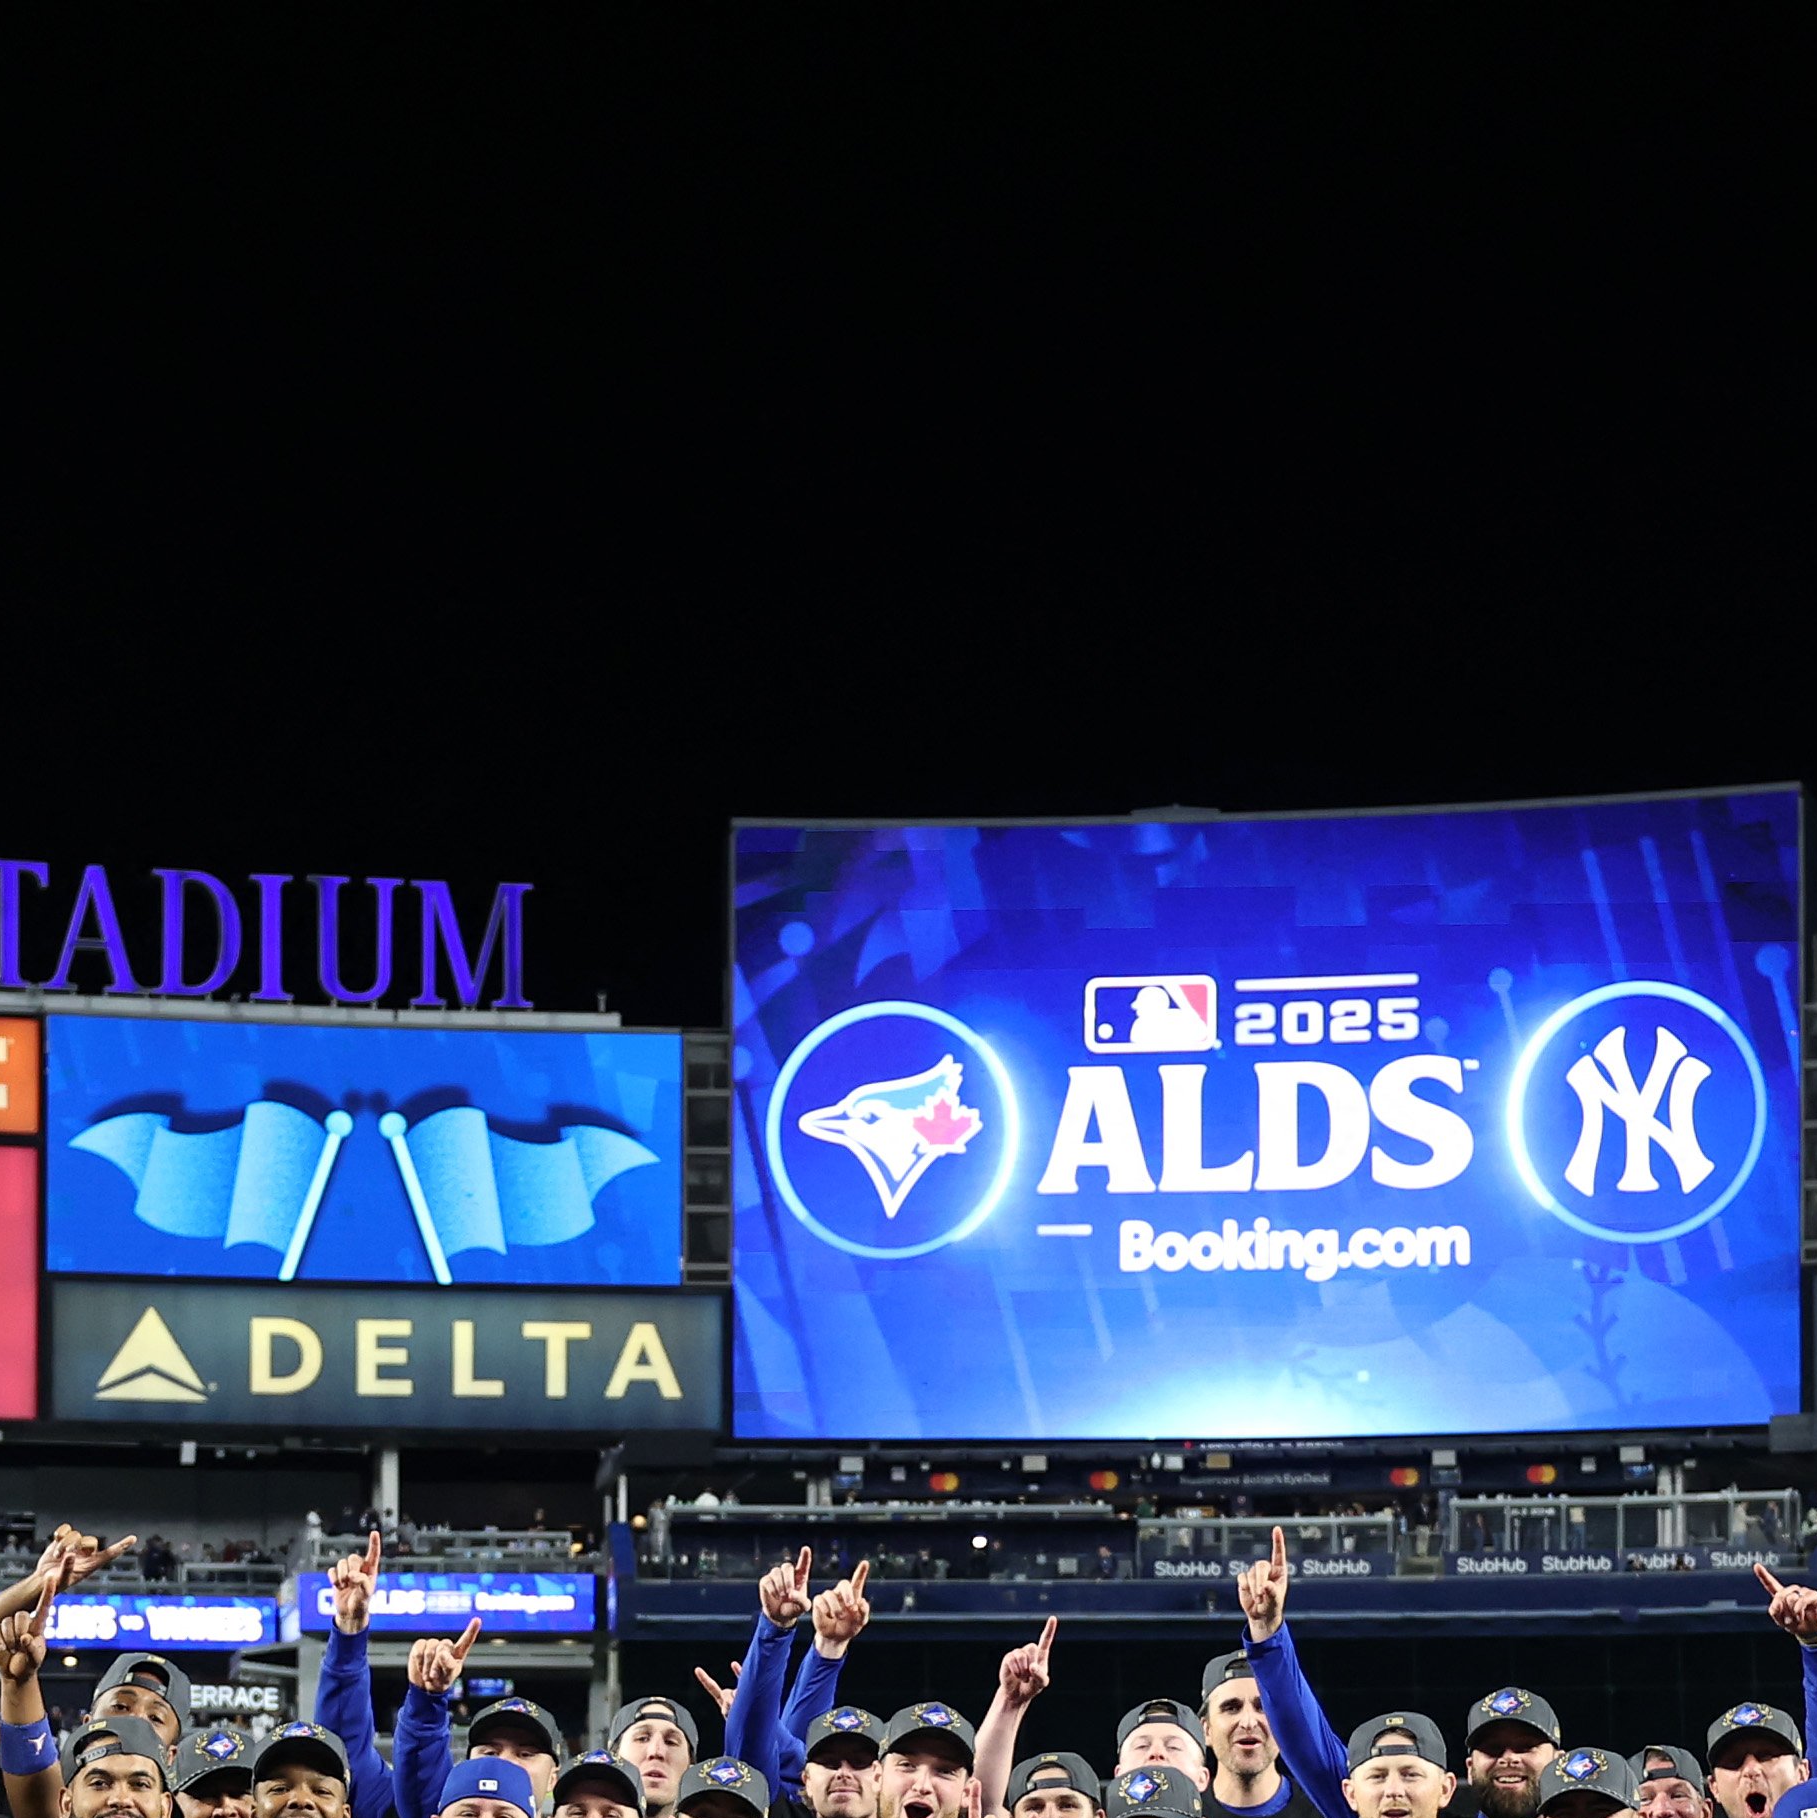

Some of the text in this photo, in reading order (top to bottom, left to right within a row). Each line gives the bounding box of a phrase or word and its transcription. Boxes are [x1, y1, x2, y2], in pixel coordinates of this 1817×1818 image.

[1234, 998, 1420, 1047] 2025
[1037, 1054, 1475, 1196] ALDS
[1119, 1217, 1471, 1281] Booking.com
[249, 1315, 684, 1400] DELTA
[1154, 1561, 1222, 1577] StubHub
[1303, 1560, 1371, 1575] StubHub
[1457, 1557, 1529, 1574] StubHub
[1542, 1553, 1612, 1571] StubHub
[1710, 1551, 1780, 1568] StubHub
[189, 1684, 280, 1711] ERRACE
